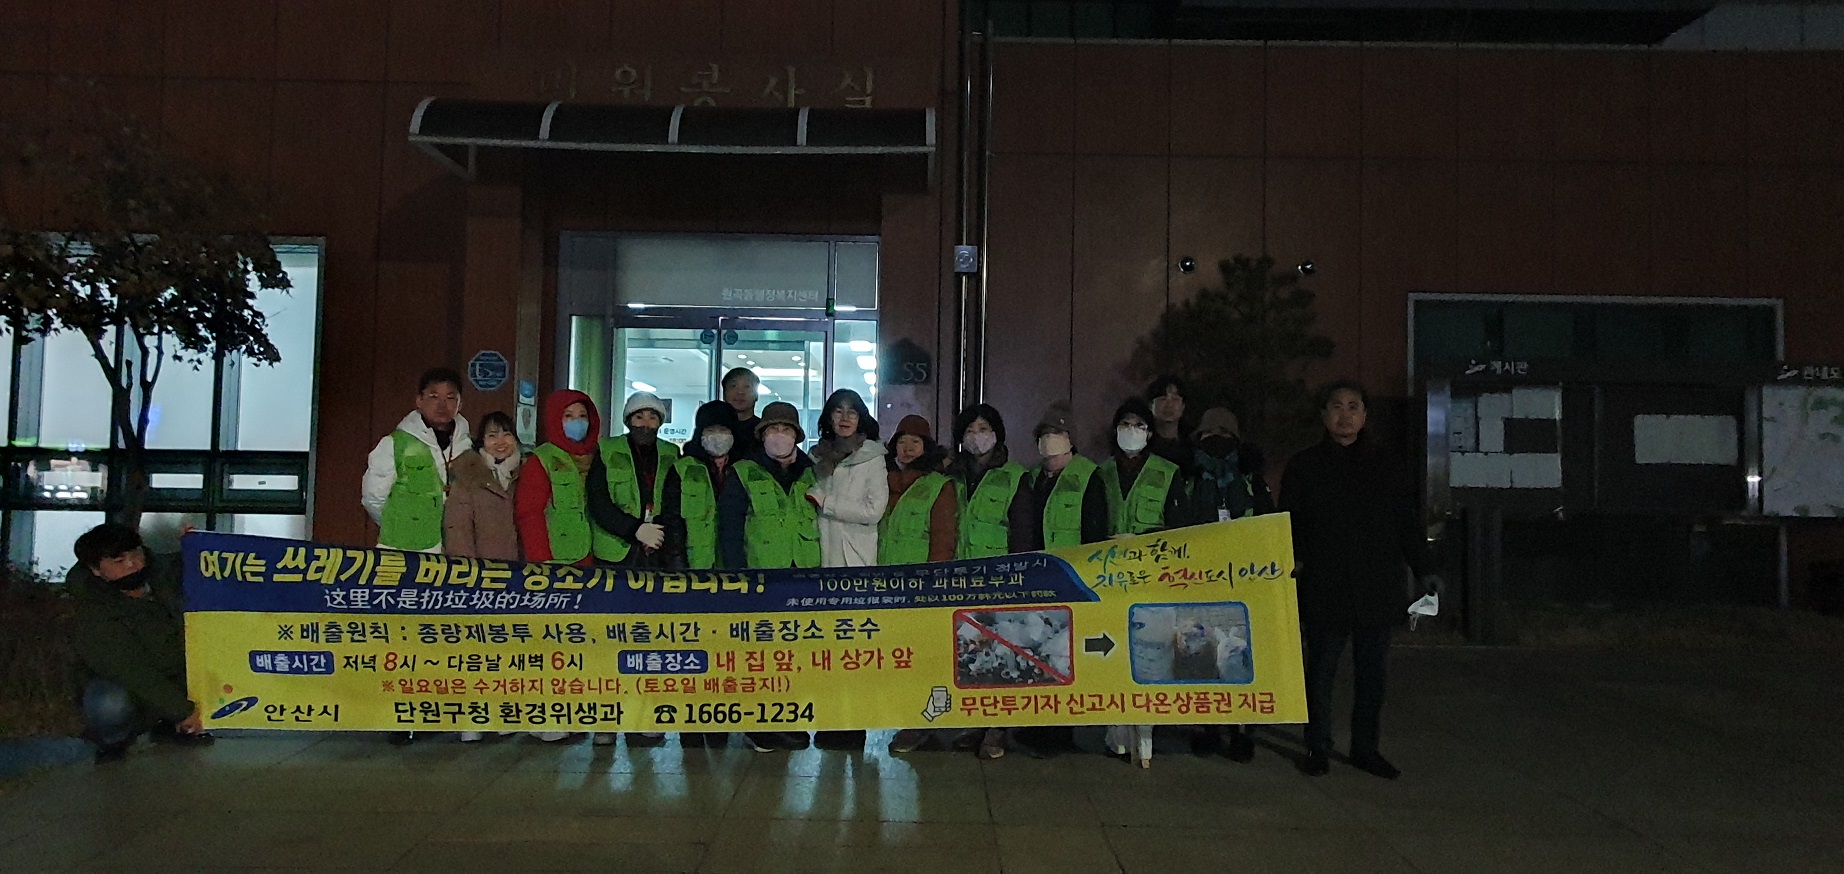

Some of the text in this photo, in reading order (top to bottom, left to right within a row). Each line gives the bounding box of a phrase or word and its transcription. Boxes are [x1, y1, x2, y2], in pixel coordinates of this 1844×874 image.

[1489, 359, 1529, 376] 게시판
[200, 550, 267, 582] 여기는
[272, 547, 408, 587] 쓰레기를
[415, 553, 512, 589] 버리는
[1238, 561, 1284, 581] 안산
[819, 572, 1025, 593] 100만원이하 과태료부과
[418, 622, 532, 644] 종량제봉투
[542, 622, 597, 645] 사용,
[606, 621, 700, 643] 배출시간
[730, 619, 825, 642] 배출장소
[834, 617, 881, 640] 준수
[255, 653, 327, 673] 배출시간
[343, 654, 376, 672] 저녁
[384, 652, 416, 672] 8시
[447, 654, 501, 672] 다음날
[509, 653, 544, 672] 새벽
[551, 651, 583, 671] 6시
[626, 647, 913, 673] 배출장소 내 집 앞, 내 상가 앞
[473, 677, 544, 695] 수거하지
[551, 677, 628, 695] 않습니다.
[636, 676, 696, 694] (토요일
[704, 676, 790, 694] 배출금지!)
[264, 704, 339, 722] 안산시
[394, 701, 814, 725] 단원구청 환경위생과 1666-1234
[960, 691, 1276, 716] 무단투기자 신고시 다온상품권 지급
